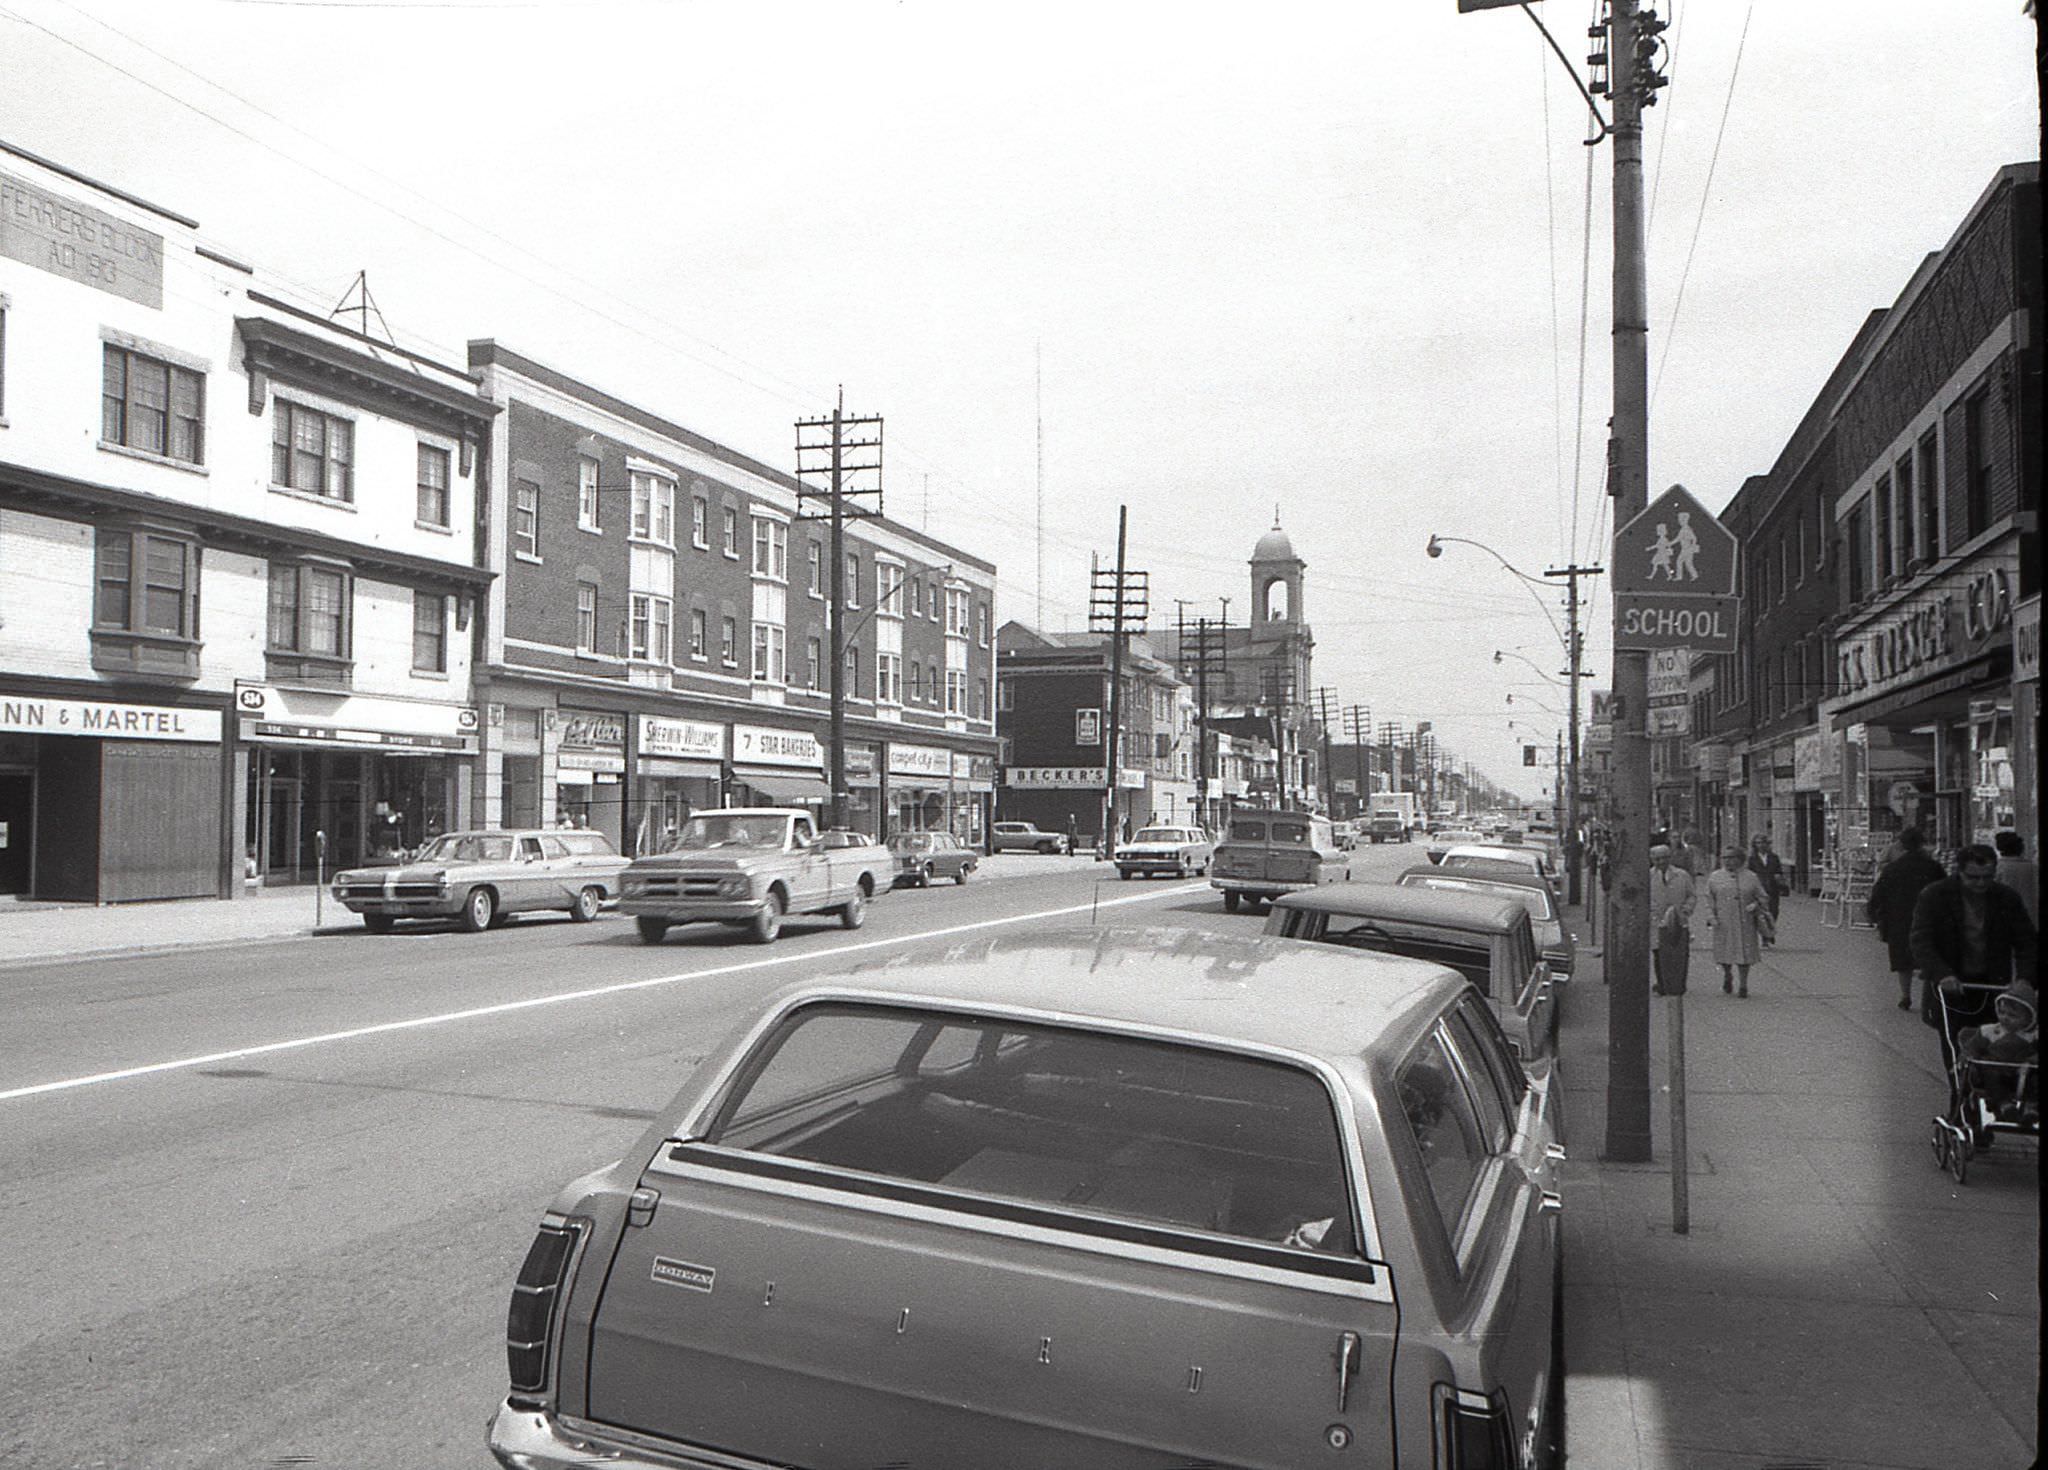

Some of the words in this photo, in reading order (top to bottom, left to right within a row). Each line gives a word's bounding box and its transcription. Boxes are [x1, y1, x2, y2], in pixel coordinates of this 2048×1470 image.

[1622, 608, 1727, 638] SCHOOL
[1656, 656, 1674, 672] NO
[59, 709, 70, 725] &
[83, 708, 185, 733] MARTEL
[743, 734, 751, 750] 7
[760, 735, 779, 755] STAR
[781, 736, 817, 758] BAKERIES
[1017, 769, 1103, 781] BECKER'S
